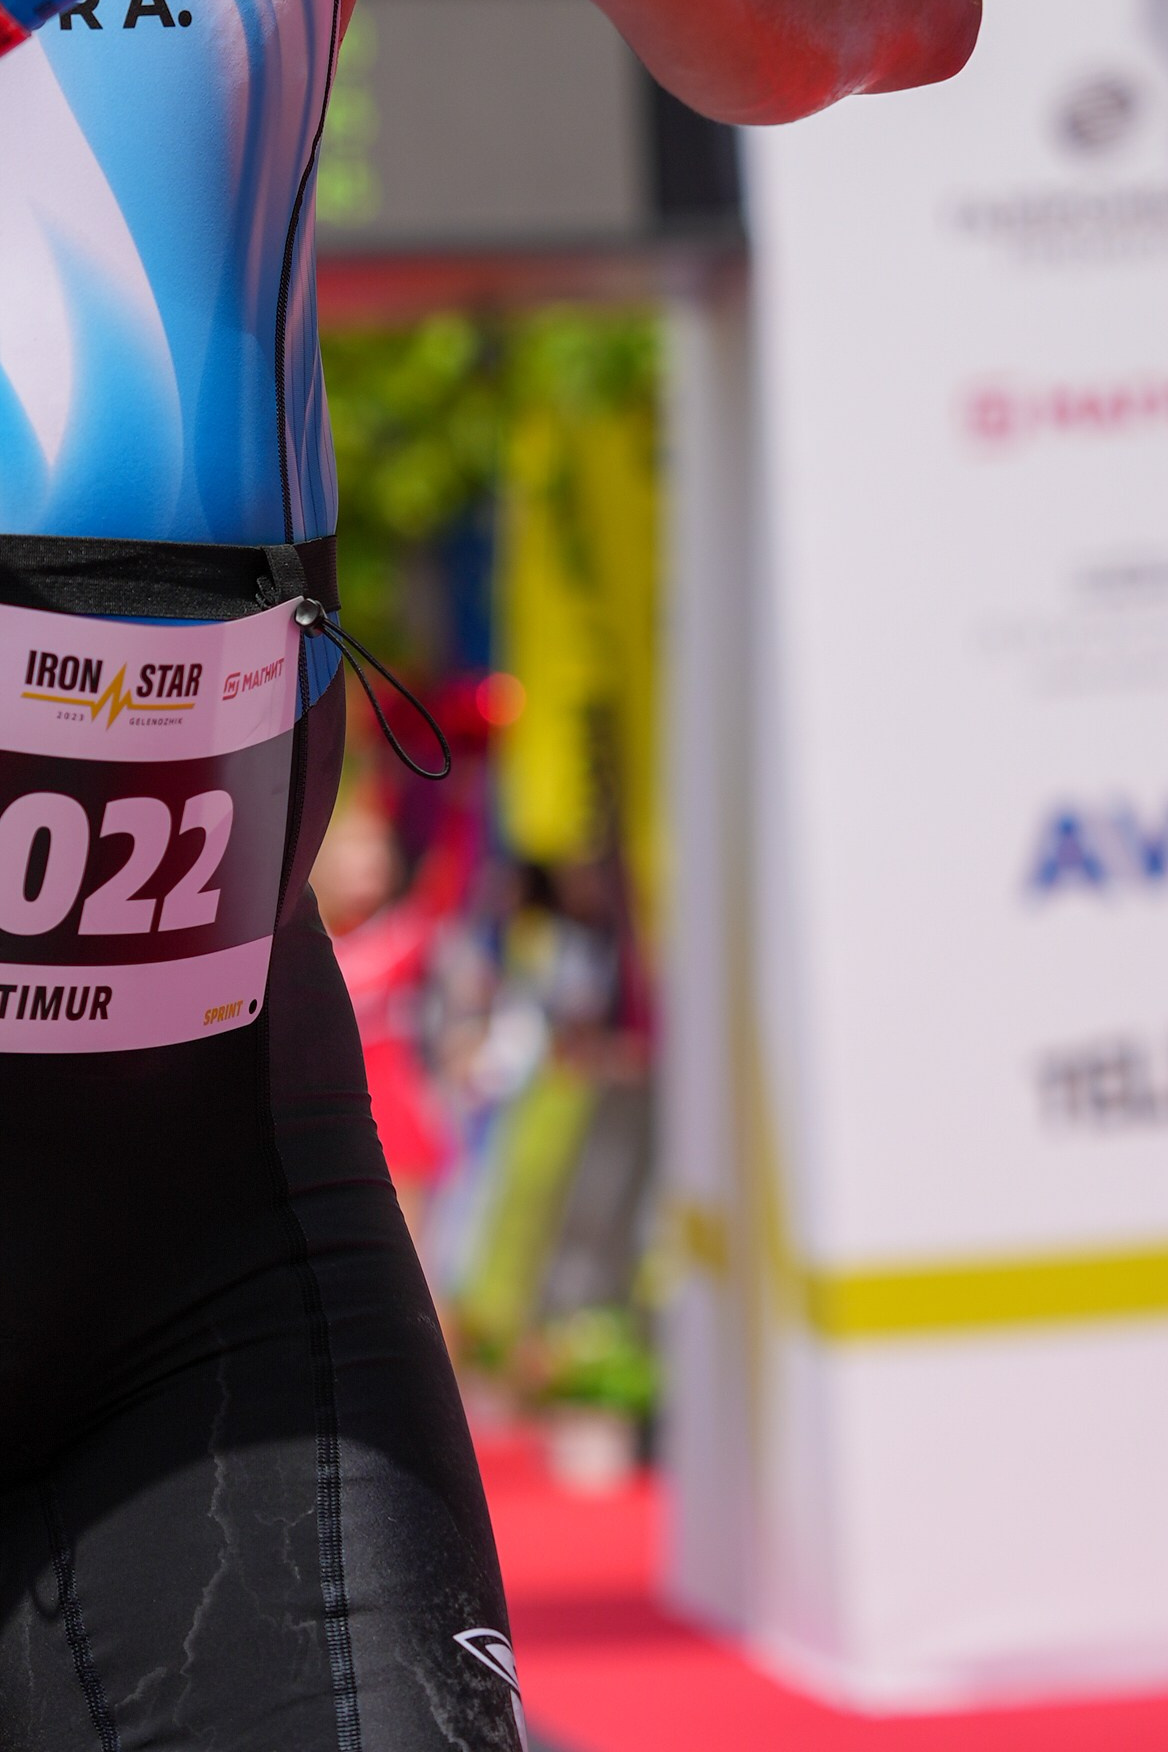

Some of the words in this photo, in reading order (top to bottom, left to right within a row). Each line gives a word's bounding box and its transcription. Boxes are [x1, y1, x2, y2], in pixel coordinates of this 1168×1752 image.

[25, 650, 103, 694] IRON
[136, 663, 203, 698] STAR
[242, 657, 285, 693] МАГНИТ
[56, 711, 85, 722] 2023
[129, 717, 183, 726] GELENDZHIK
[203, 999, 244, 1026] SPRINT
